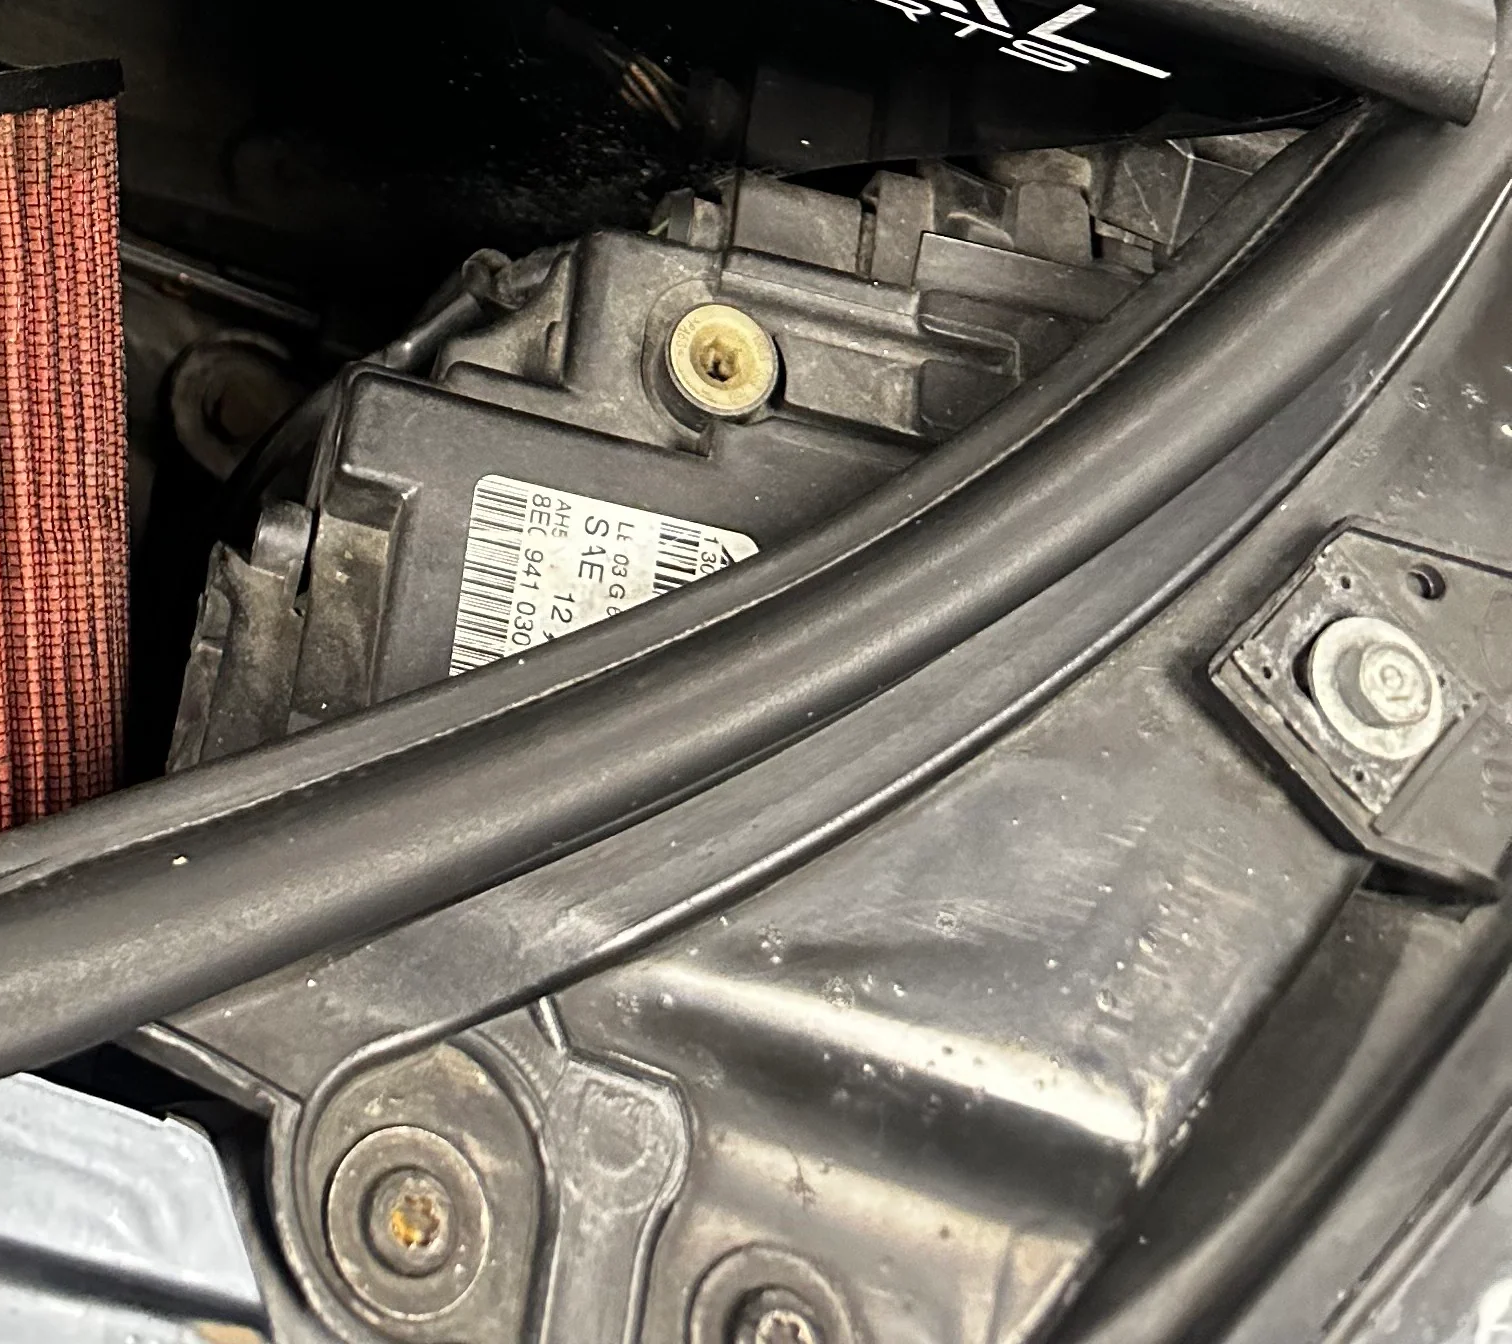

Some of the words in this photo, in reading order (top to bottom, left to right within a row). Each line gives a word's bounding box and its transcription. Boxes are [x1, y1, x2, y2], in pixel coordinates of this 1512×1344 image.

[577, 514, 611, 584] SAE
[611, 552, 630, 580] 03
[519, 549, 544, 592] 941
[550, 593, 574, 625] 12
[608, 584, 626, 601] G
[512, 601, 536, 647] 030
